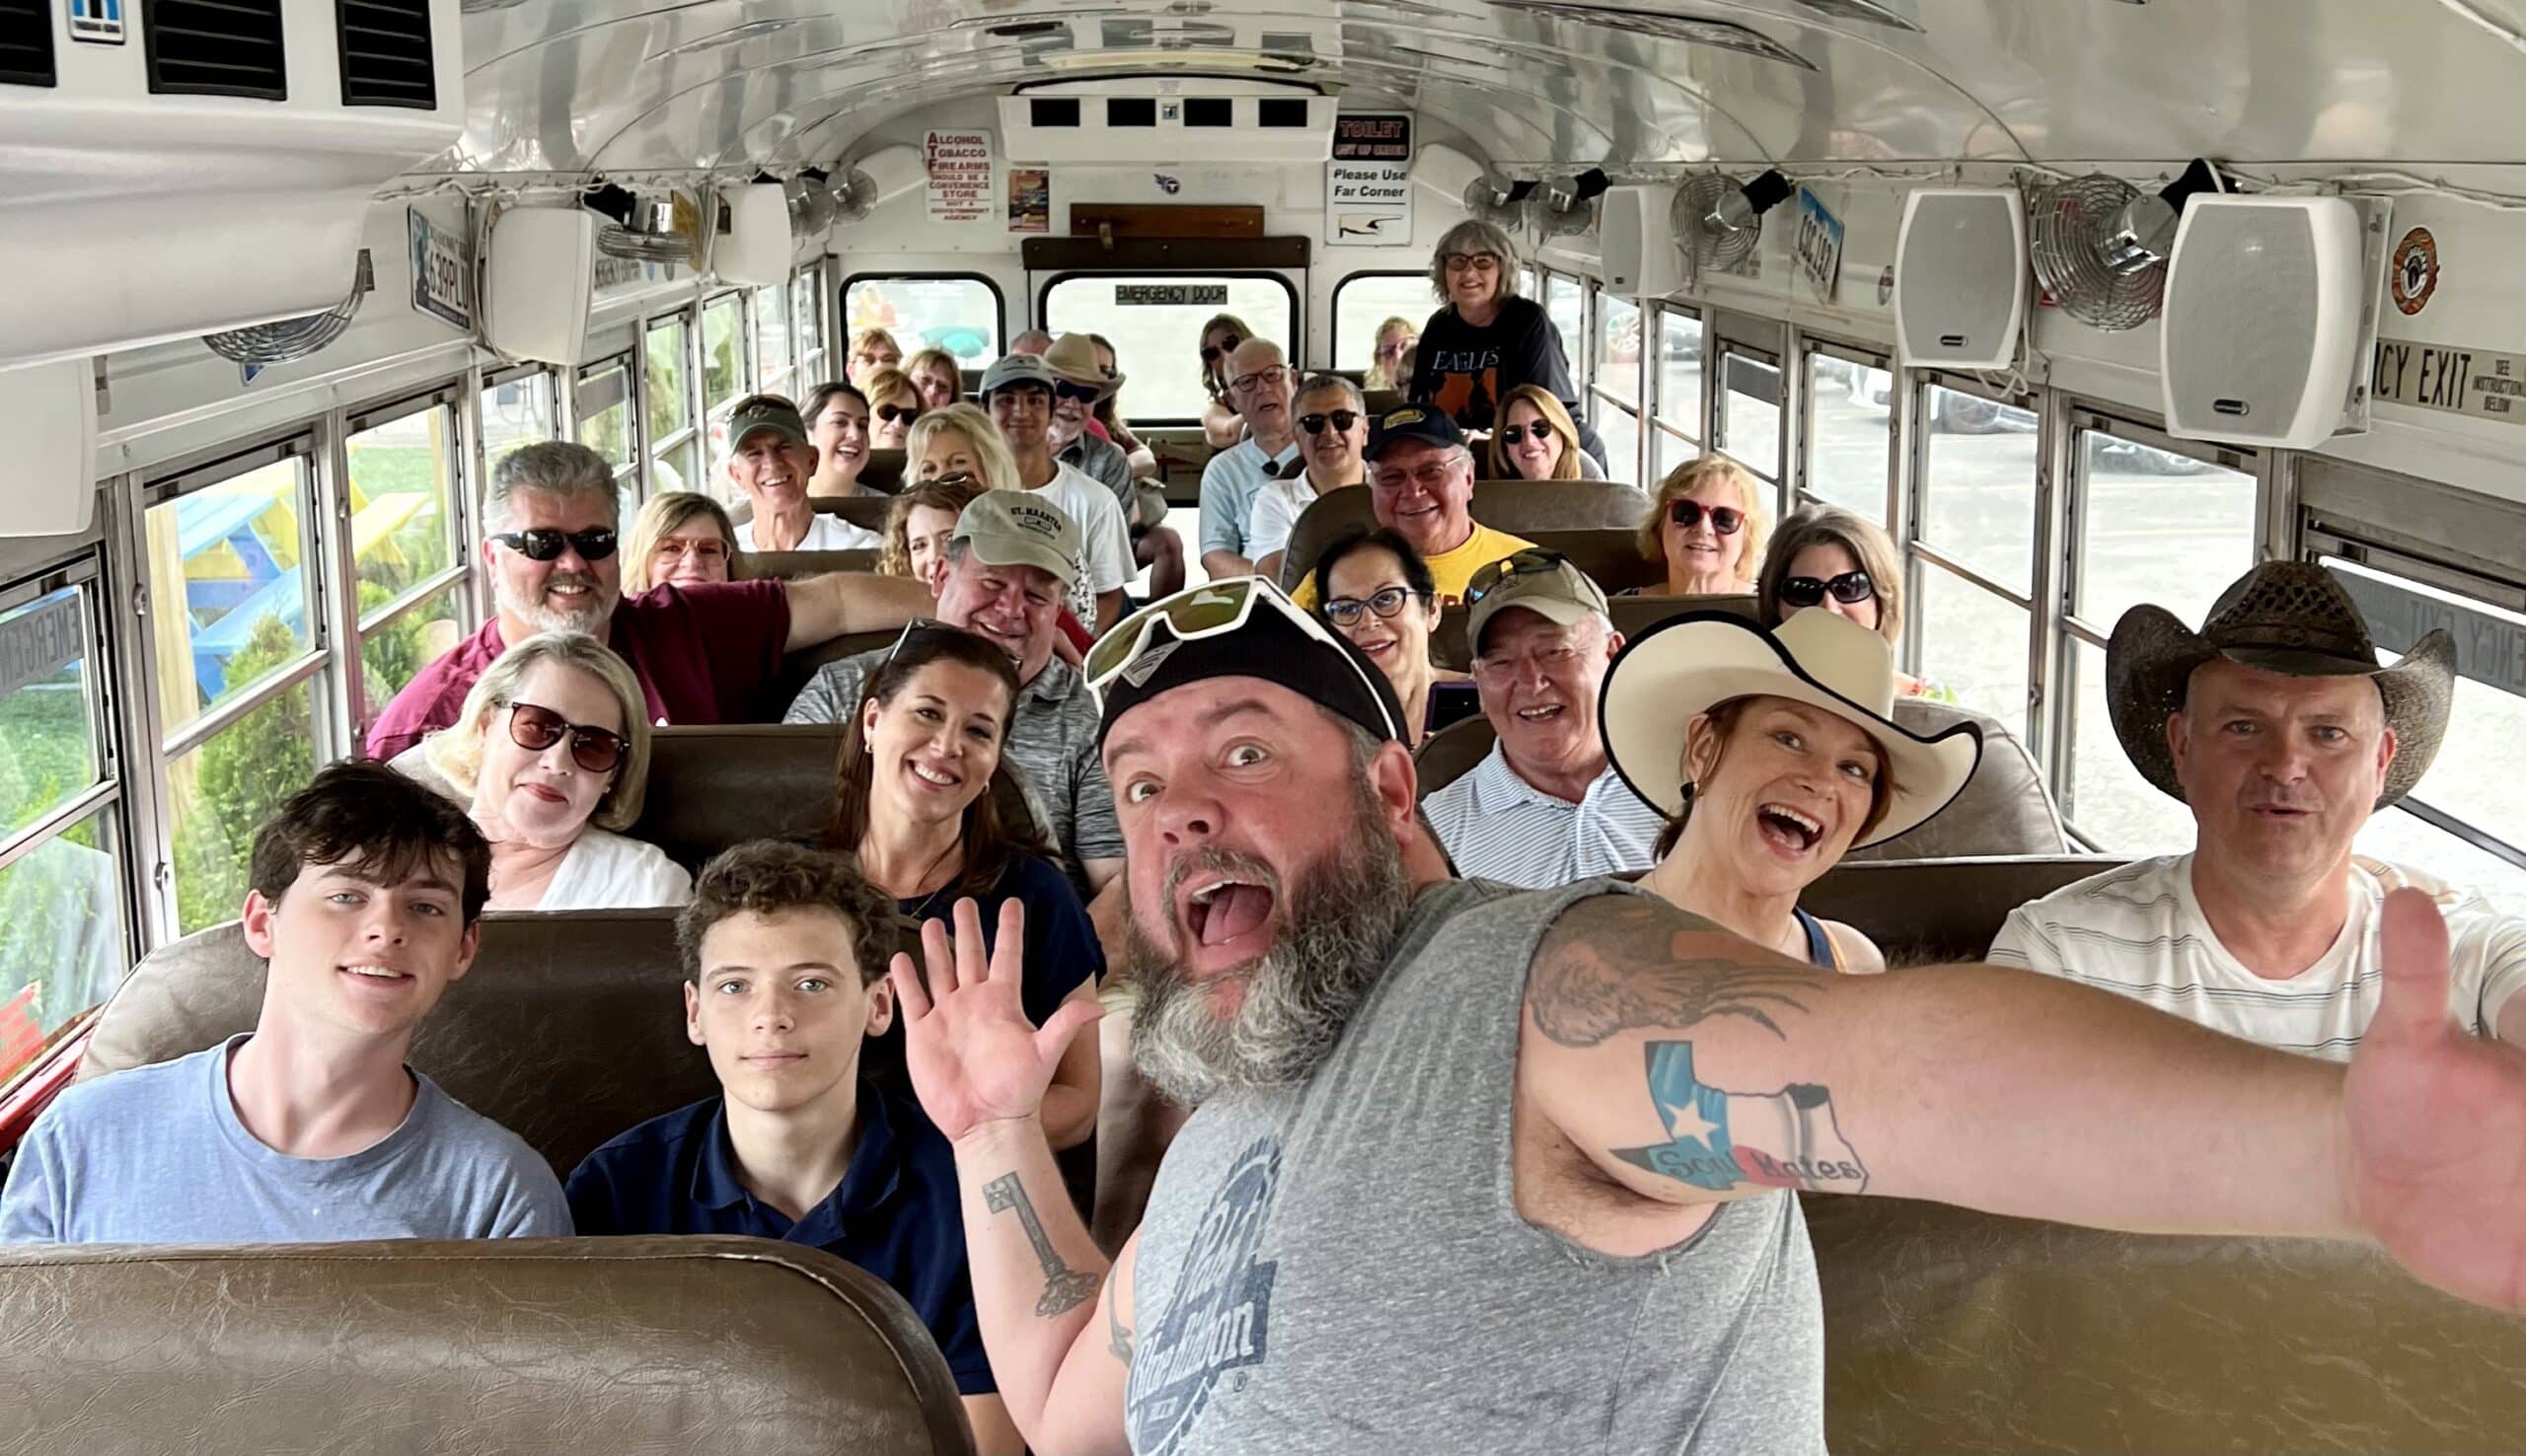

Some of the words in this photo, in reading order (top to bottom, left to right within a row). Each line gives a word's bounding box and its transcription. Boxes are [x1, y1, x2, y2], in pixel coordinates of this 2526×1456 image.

[1338, 120, 1404, 138] TOILET
[928, 131, 985, 145] ALCOHOL
[928, 144, 987, 158] TOBACCO
[928, 158, 991, 172] FIREARMS
[1333, 168, 1377, 181] Please
[1381, 169, 1407, 181] Use
[1333, 184, 1357, 196] Far
[1359, 185, 1406, 197] Corner
[1432, 349, 1501, 371] EAGLES
[2417, 348, 2472, 409] EXIT
